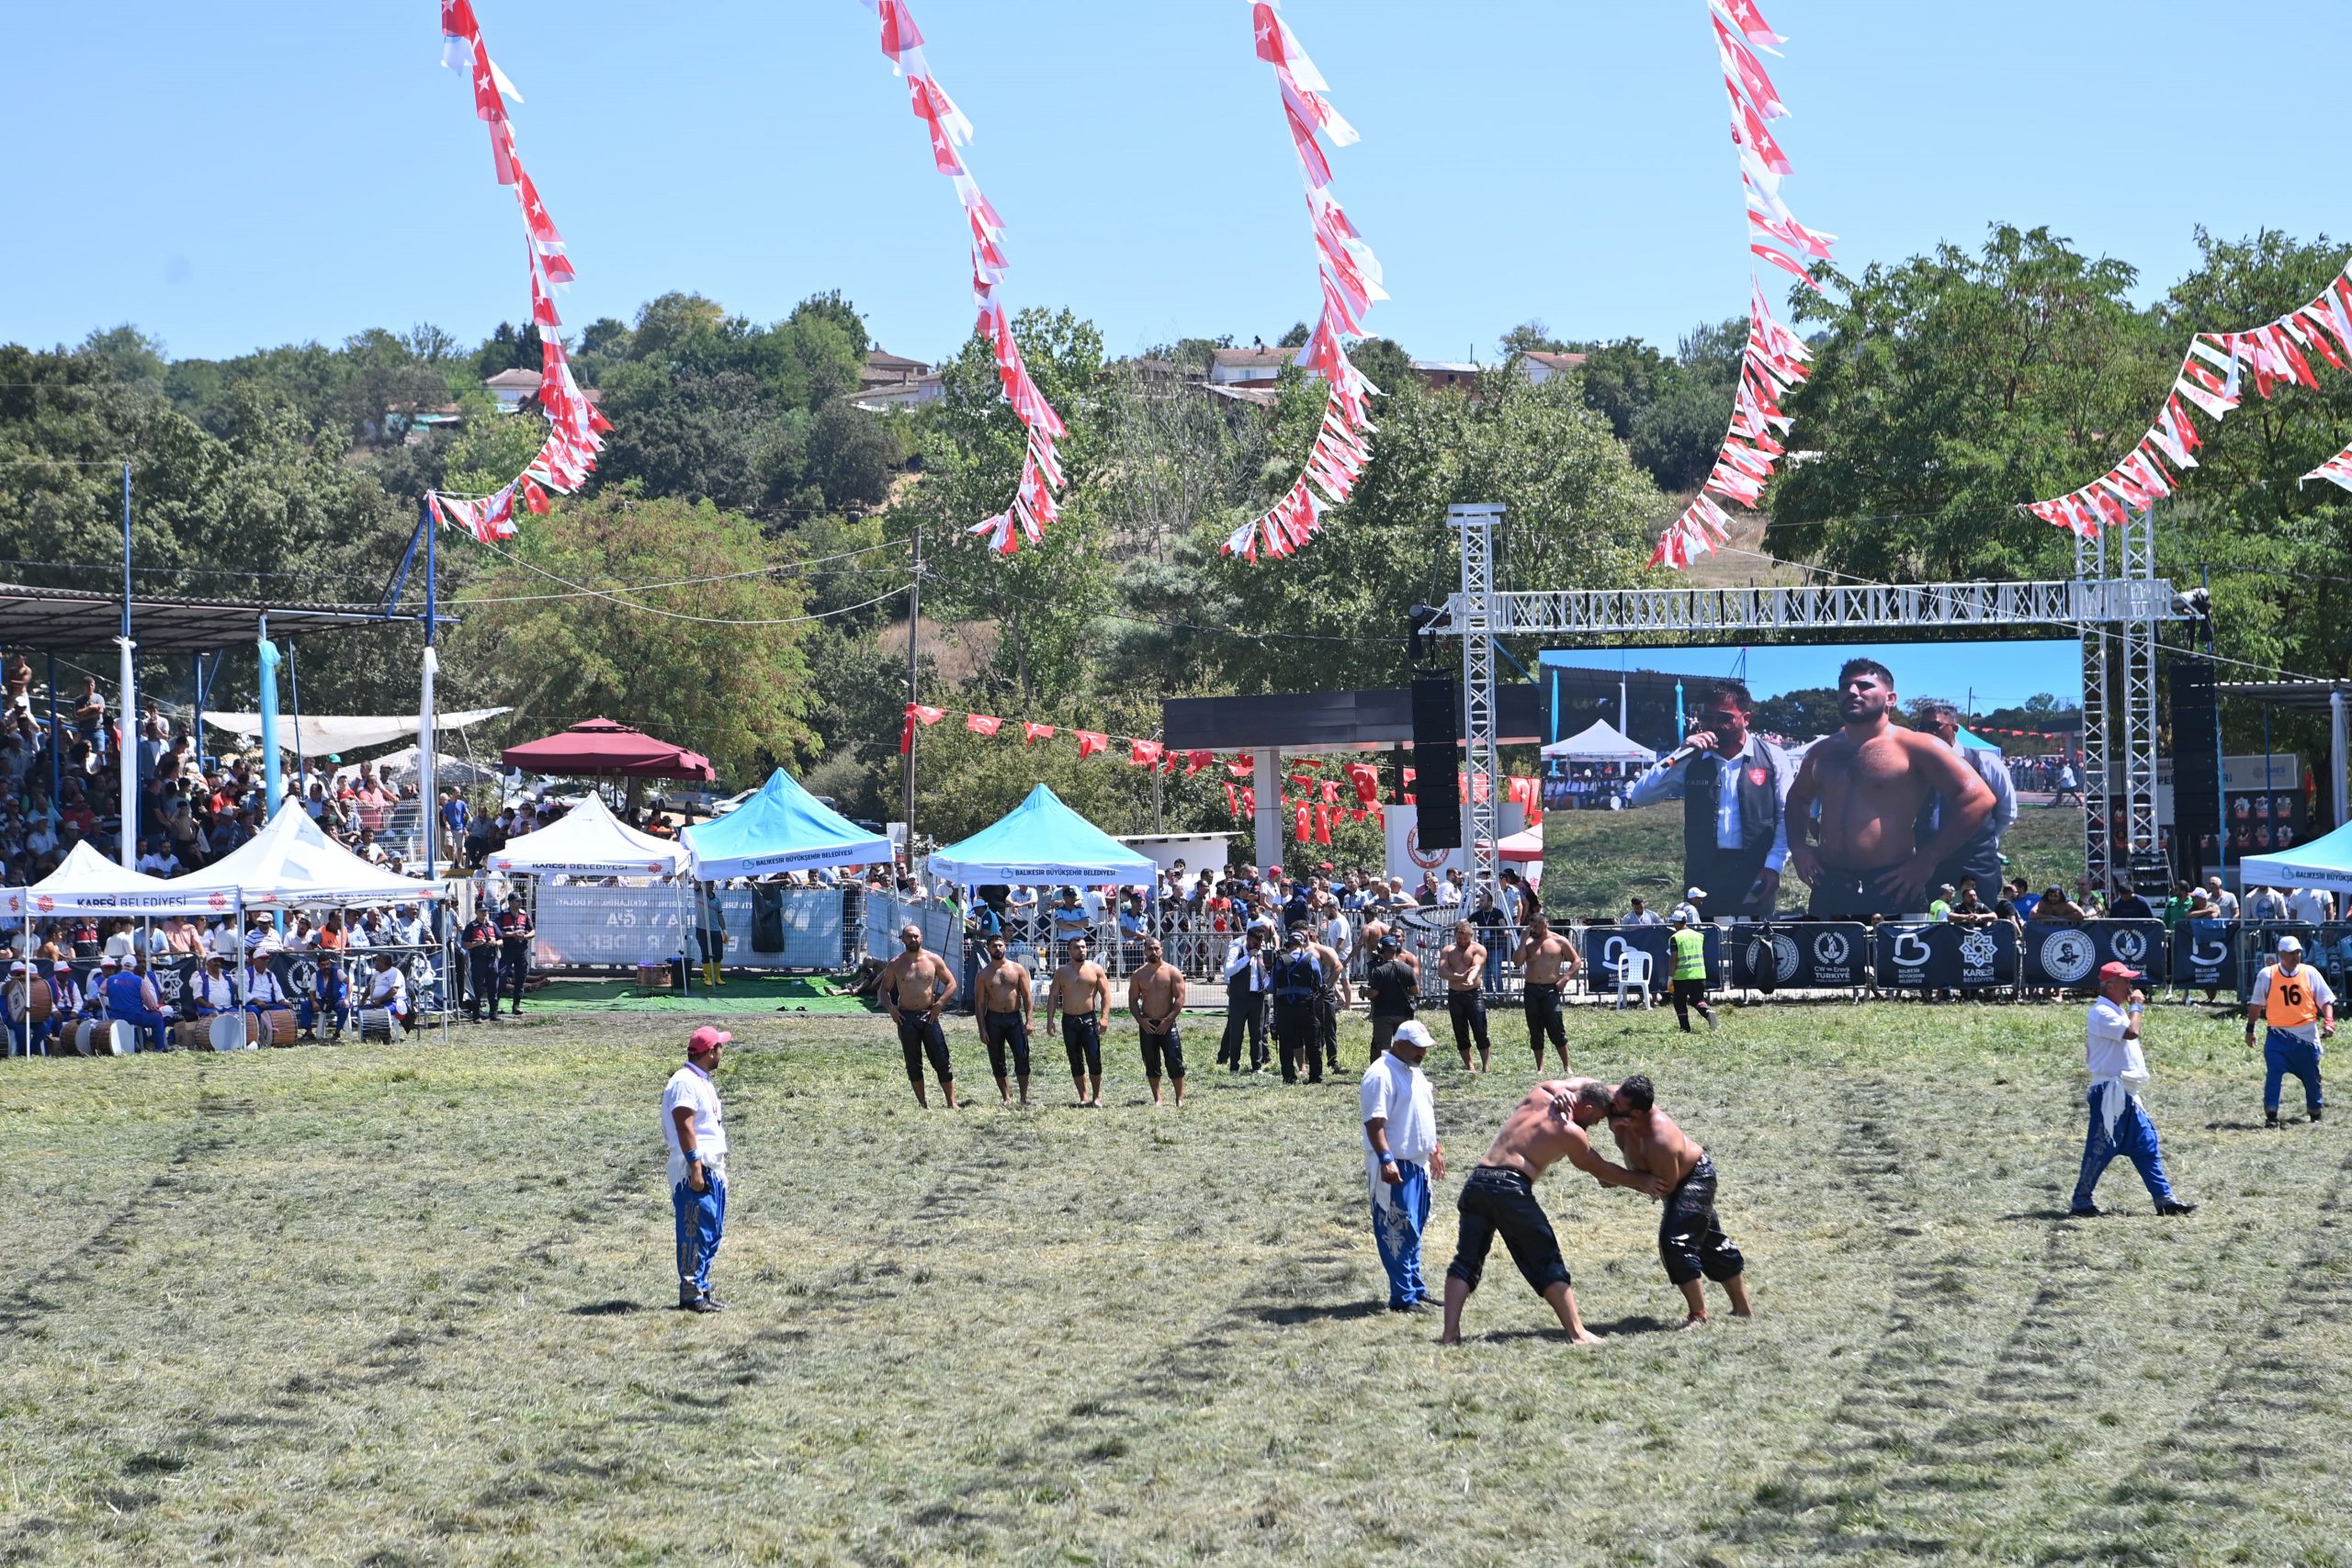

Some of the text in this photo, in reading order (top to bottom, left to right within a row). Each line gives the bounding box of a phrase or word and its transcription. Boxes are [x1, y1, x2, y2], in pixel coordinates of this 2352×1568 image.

[755, 849, 854, 866] BALIKESİR BÜYÜKŞEHİR BELEDİYESİ
[1015, 868, 1116, 877] BALIKESİR BÜYÜKŞEHİR BELEDİYESİ
[2295, 871, 2325, 880] BALIKESİR
[120, 895, 187, 908] BELEDİYESİ
[1963, 965, 1995, 976] KARESİ
[2279, 984, 2302, 1007] 16
